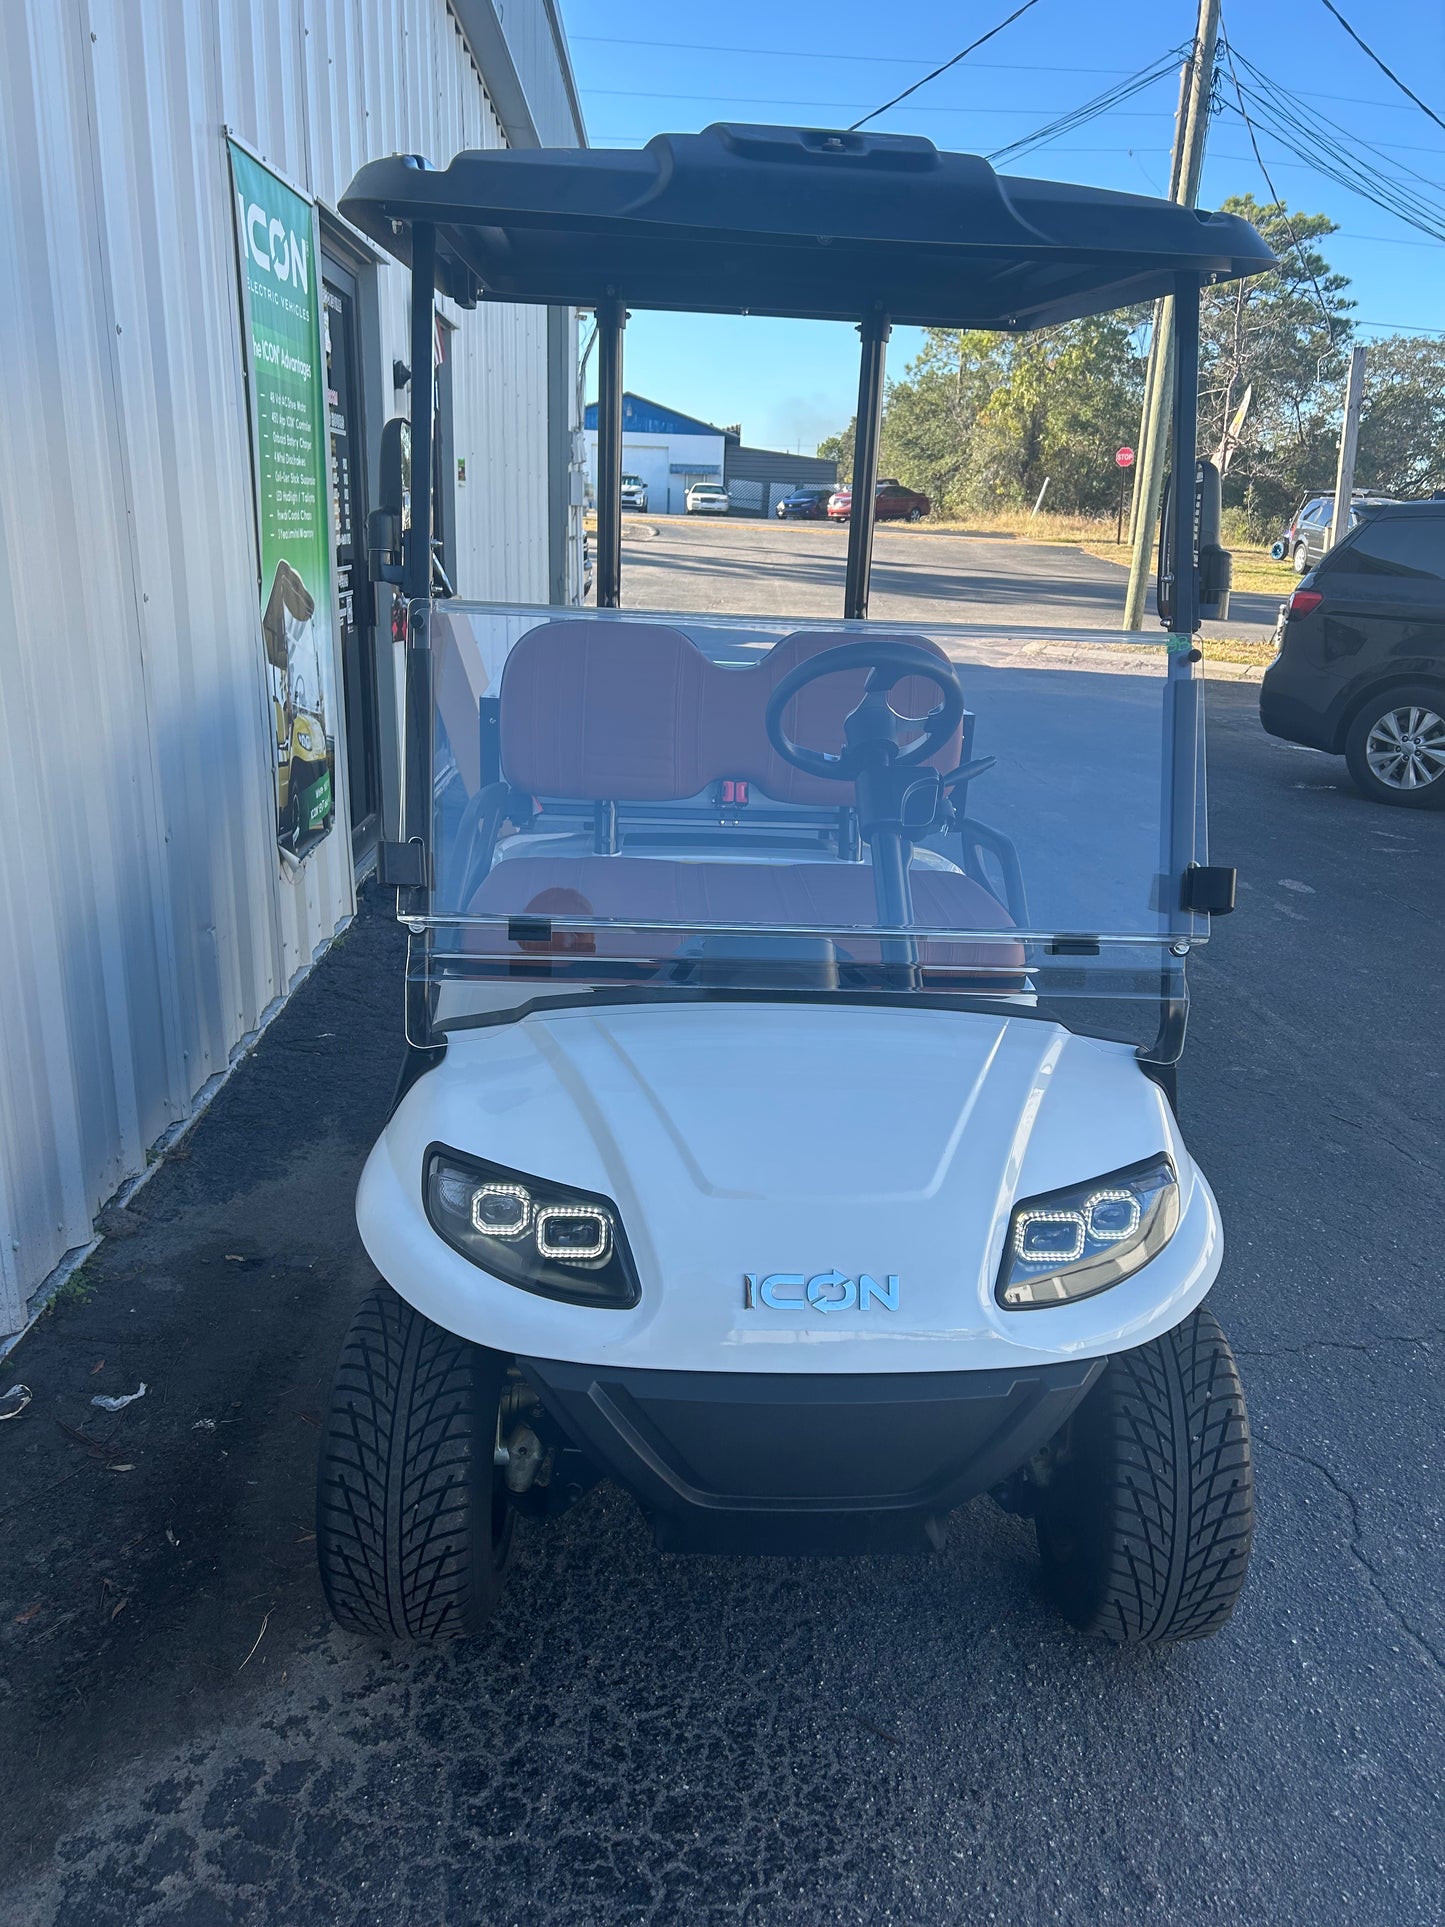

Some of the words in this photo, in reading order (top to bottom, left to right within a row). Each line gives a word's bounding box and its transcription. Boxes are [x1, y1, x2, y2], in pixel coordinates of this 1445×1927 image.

[237, 191, 309, 296] ICON
[279, 295, 310, 322] VEHICLES
[252, 333, 262, 359] he
[1117, 453, 1133, 461] STOP
[745, 1268, 900, 1314] ICON
